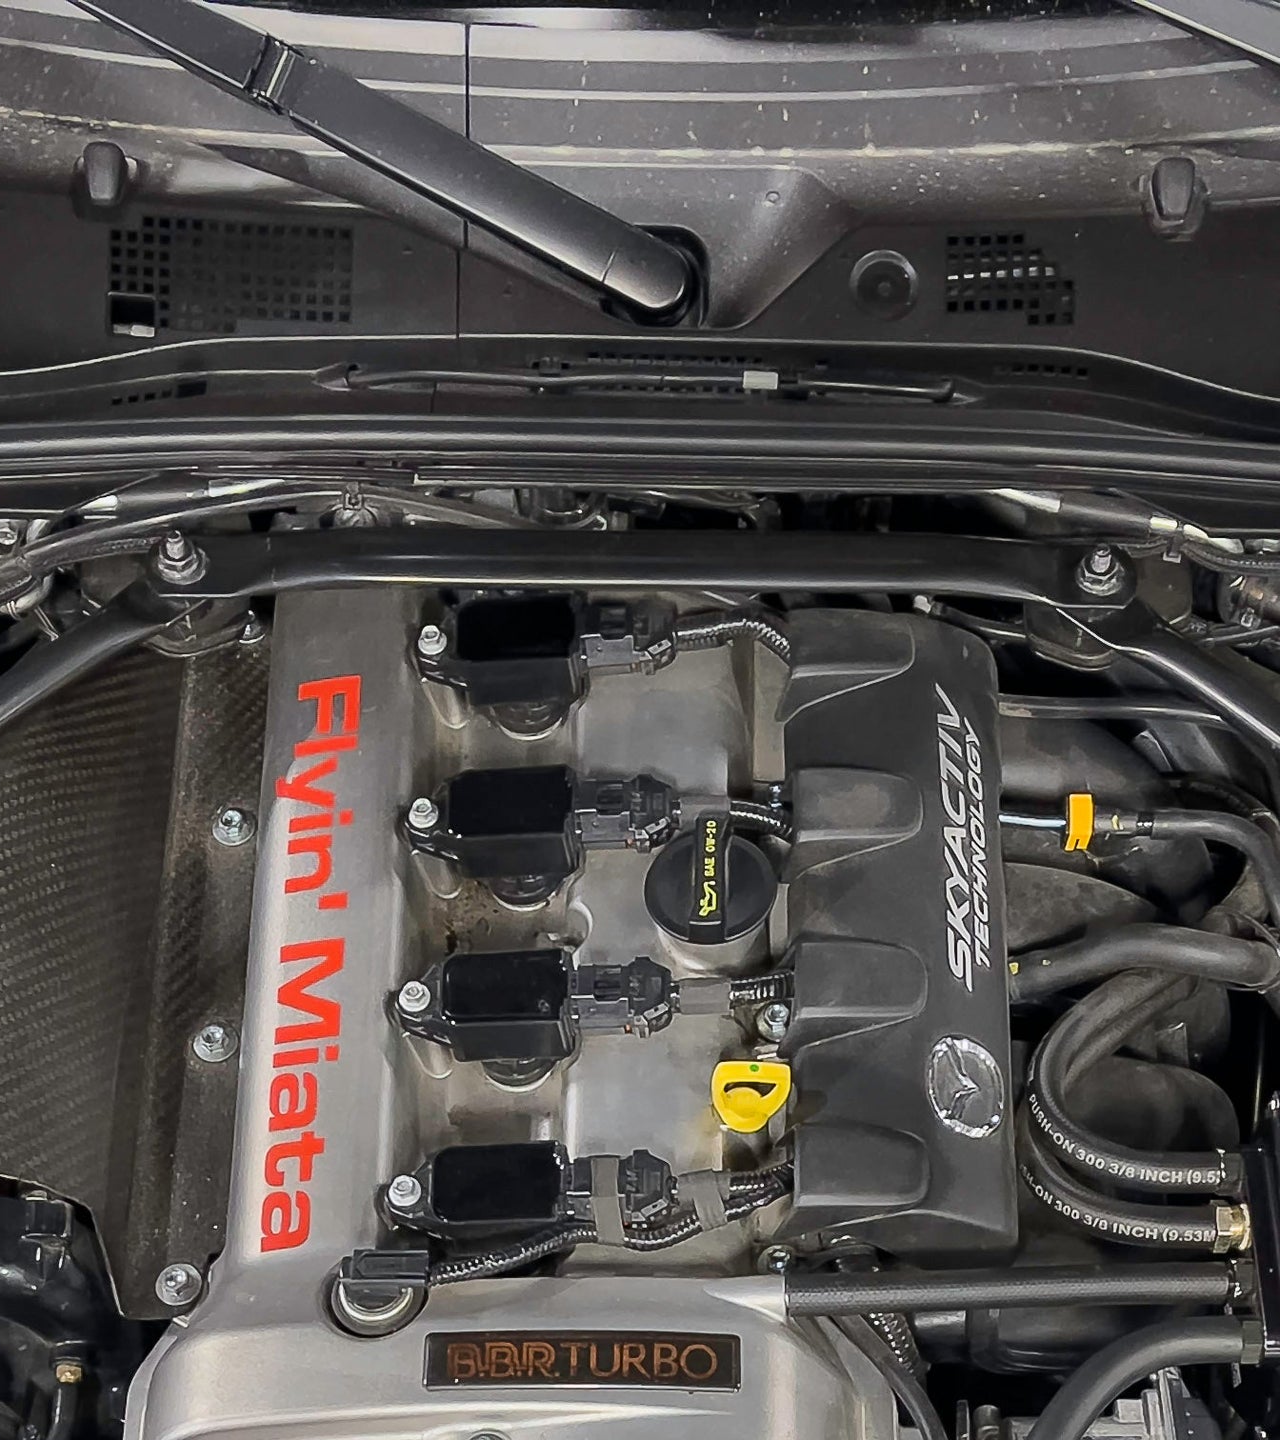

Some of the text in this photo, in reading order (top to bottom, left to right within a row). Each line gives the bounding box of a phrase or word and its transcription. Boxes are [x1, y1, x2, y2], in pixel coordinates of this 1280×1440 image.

[935, 682, 972, 993] SKYACTIV
[964, 716, 991, 969] TECHNOLOGY
[260, 674, 362, 1252] Flyin' Miata
[1054, 1200, 1080, 1220] 300
[1083, 1213, 1108, 1231] 3/8
[1112, 1223, 1158, 1240] INCH
[1076, 1149, 1105, 1170] 300
[1109, 1163, 1135, 1179] 3/8
[1140, 1169, 1182, 1183] INCH
[560, 1343, 718, 1379] TURBO
